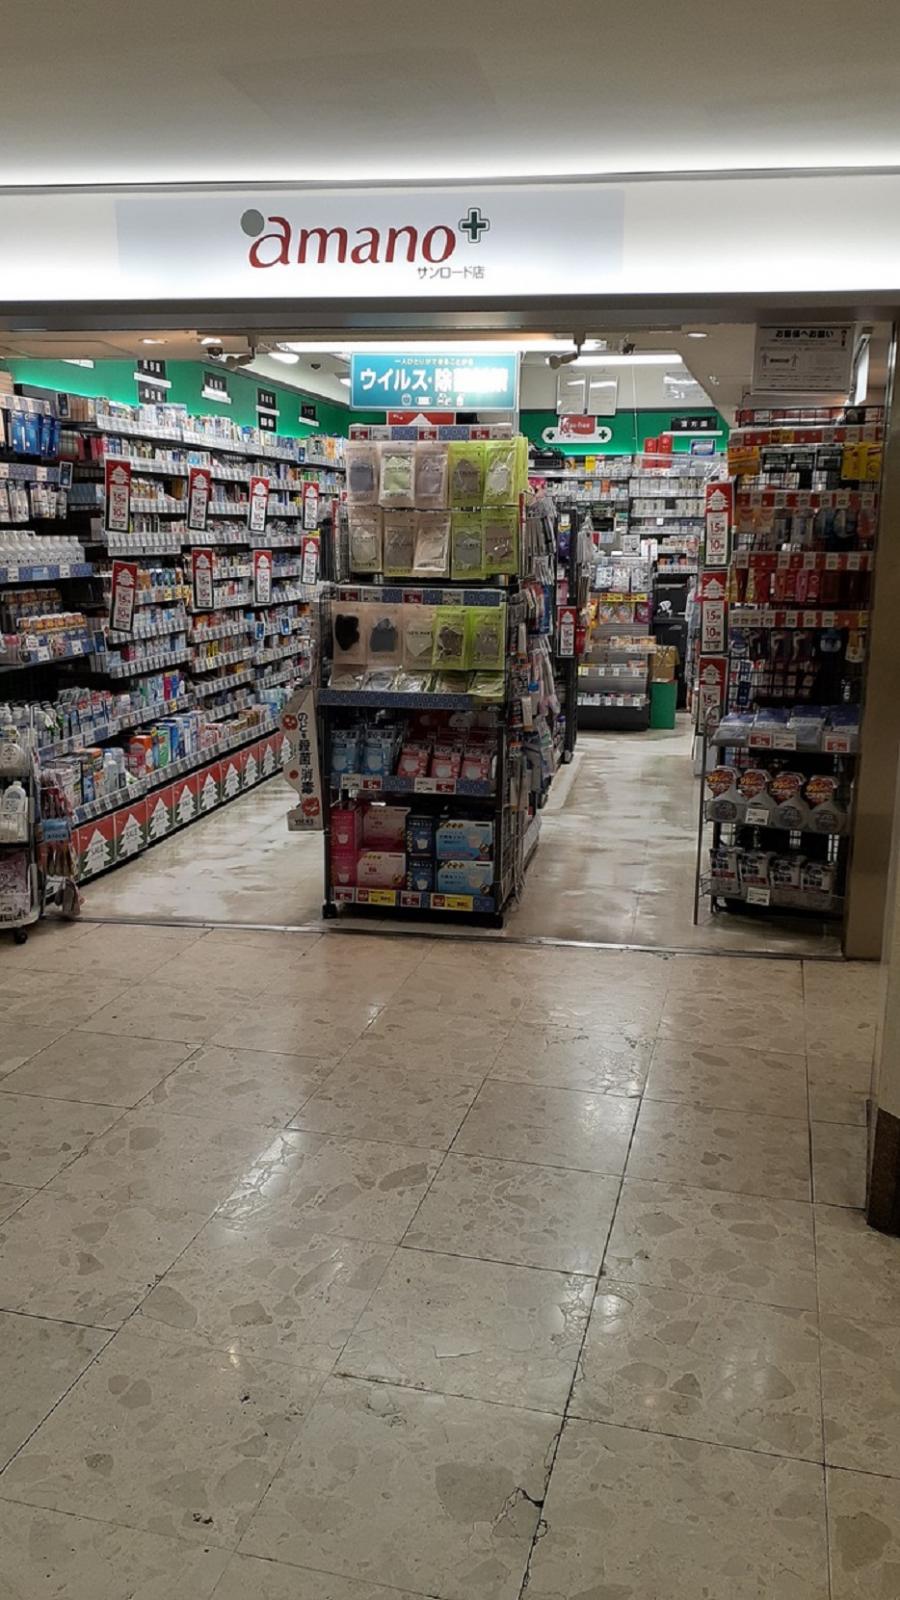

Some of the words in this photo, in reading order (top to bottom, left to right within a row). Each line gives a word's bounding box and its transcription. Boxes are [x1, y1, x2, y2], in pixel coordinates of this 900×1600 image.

[248, 215, 456, 268] amano
[417, 266, 486, 280] サンロード店
[359, 367, 509, 393] ウイルス・除
